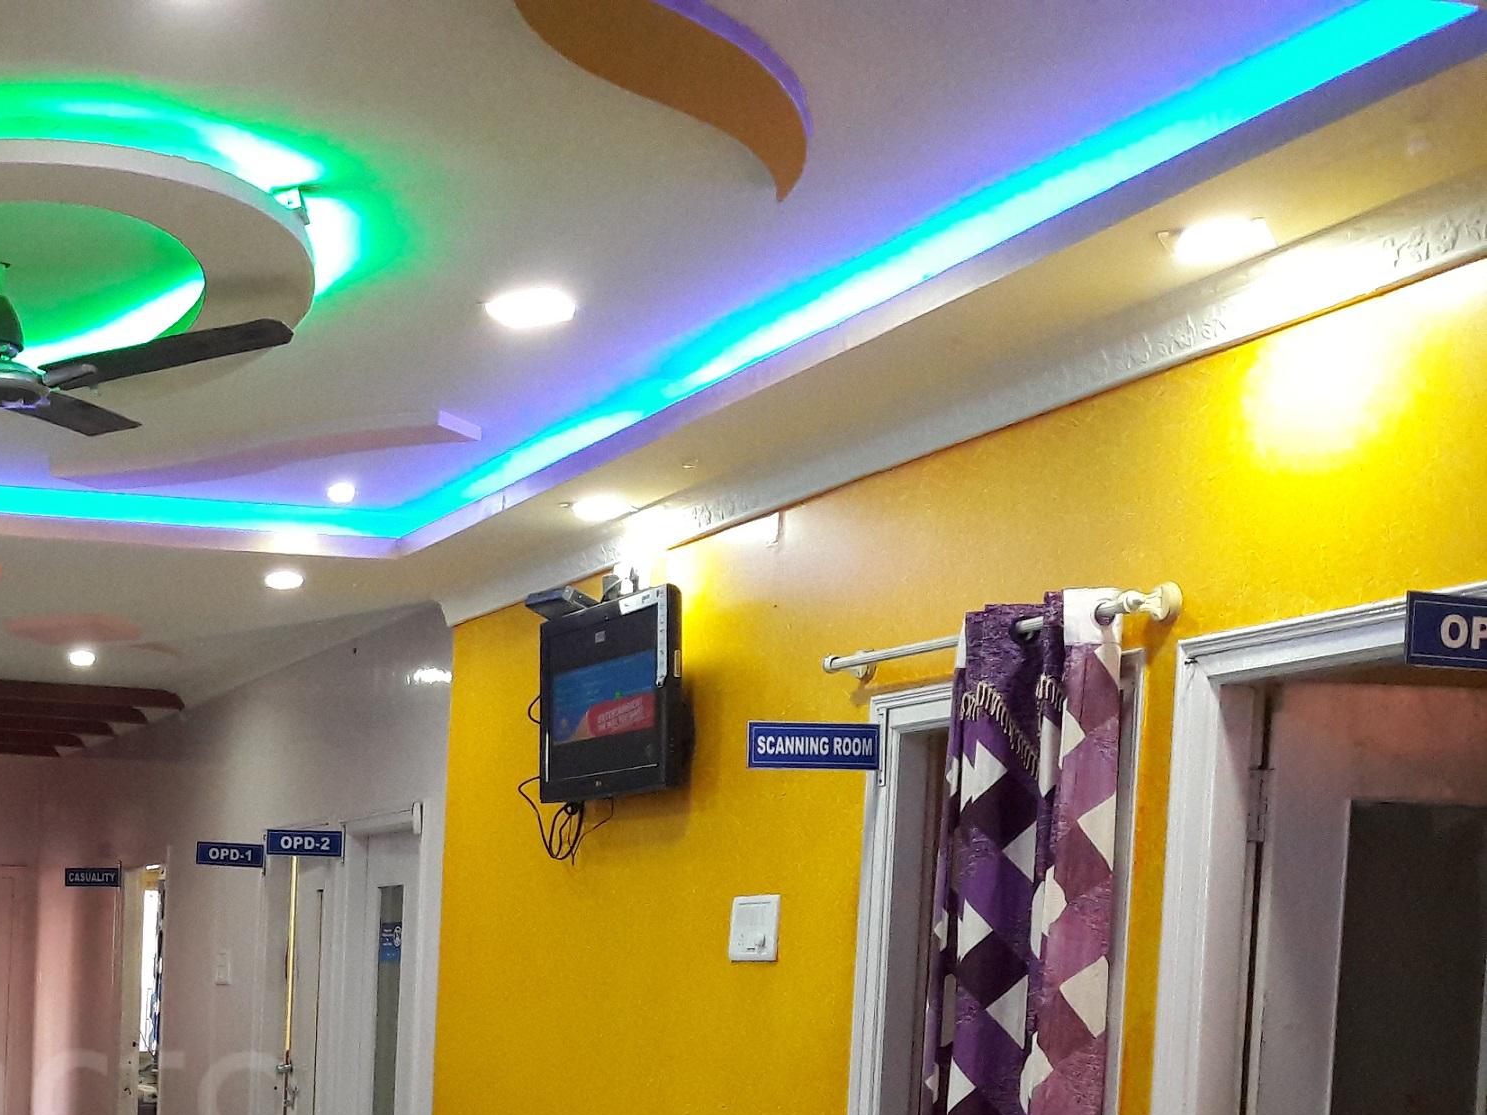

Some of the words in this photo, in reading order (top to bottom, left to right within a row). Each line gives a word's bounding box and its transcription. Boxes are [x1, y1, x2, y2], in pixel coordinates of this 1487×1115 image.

[757, 735, 829, 755] SCANNING
[833, 737, 873, 756] ROOM
[280, 835, 330, 851] OPD-2
[208, 847, 252, 862] OPD-1
[68, 872, 115, 882] CASUALITY
